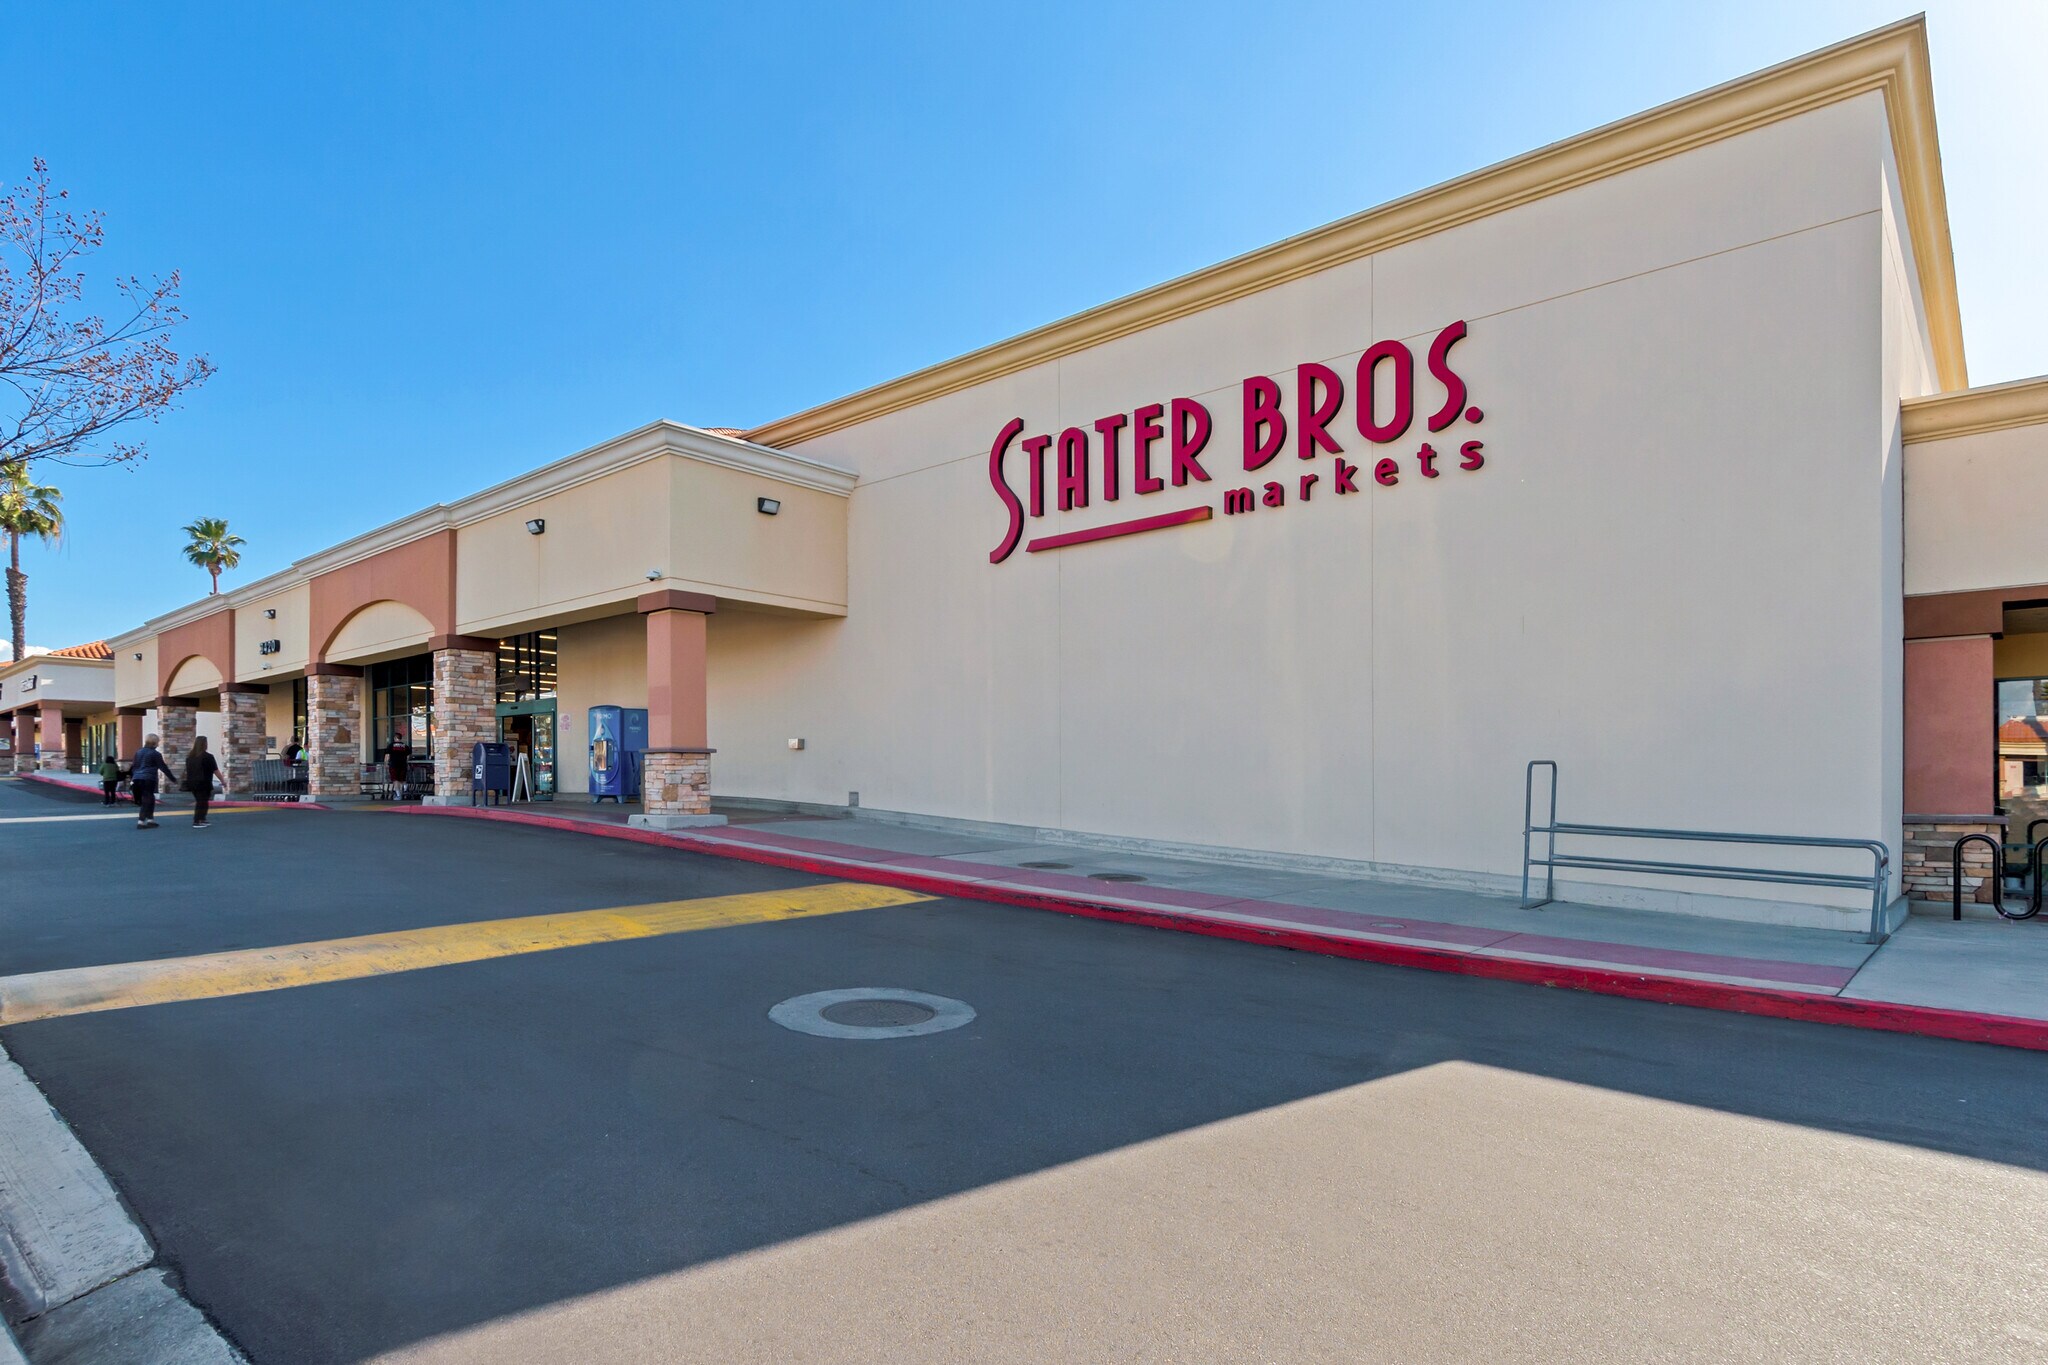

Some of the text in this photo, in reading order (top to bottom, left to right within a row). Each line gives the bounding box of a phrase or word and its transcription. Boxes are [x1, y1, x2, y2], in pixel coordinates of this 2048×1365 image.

[989, 319, 1484, 564] STATER BROS.
[1223, 440, 1485, 515] markets
